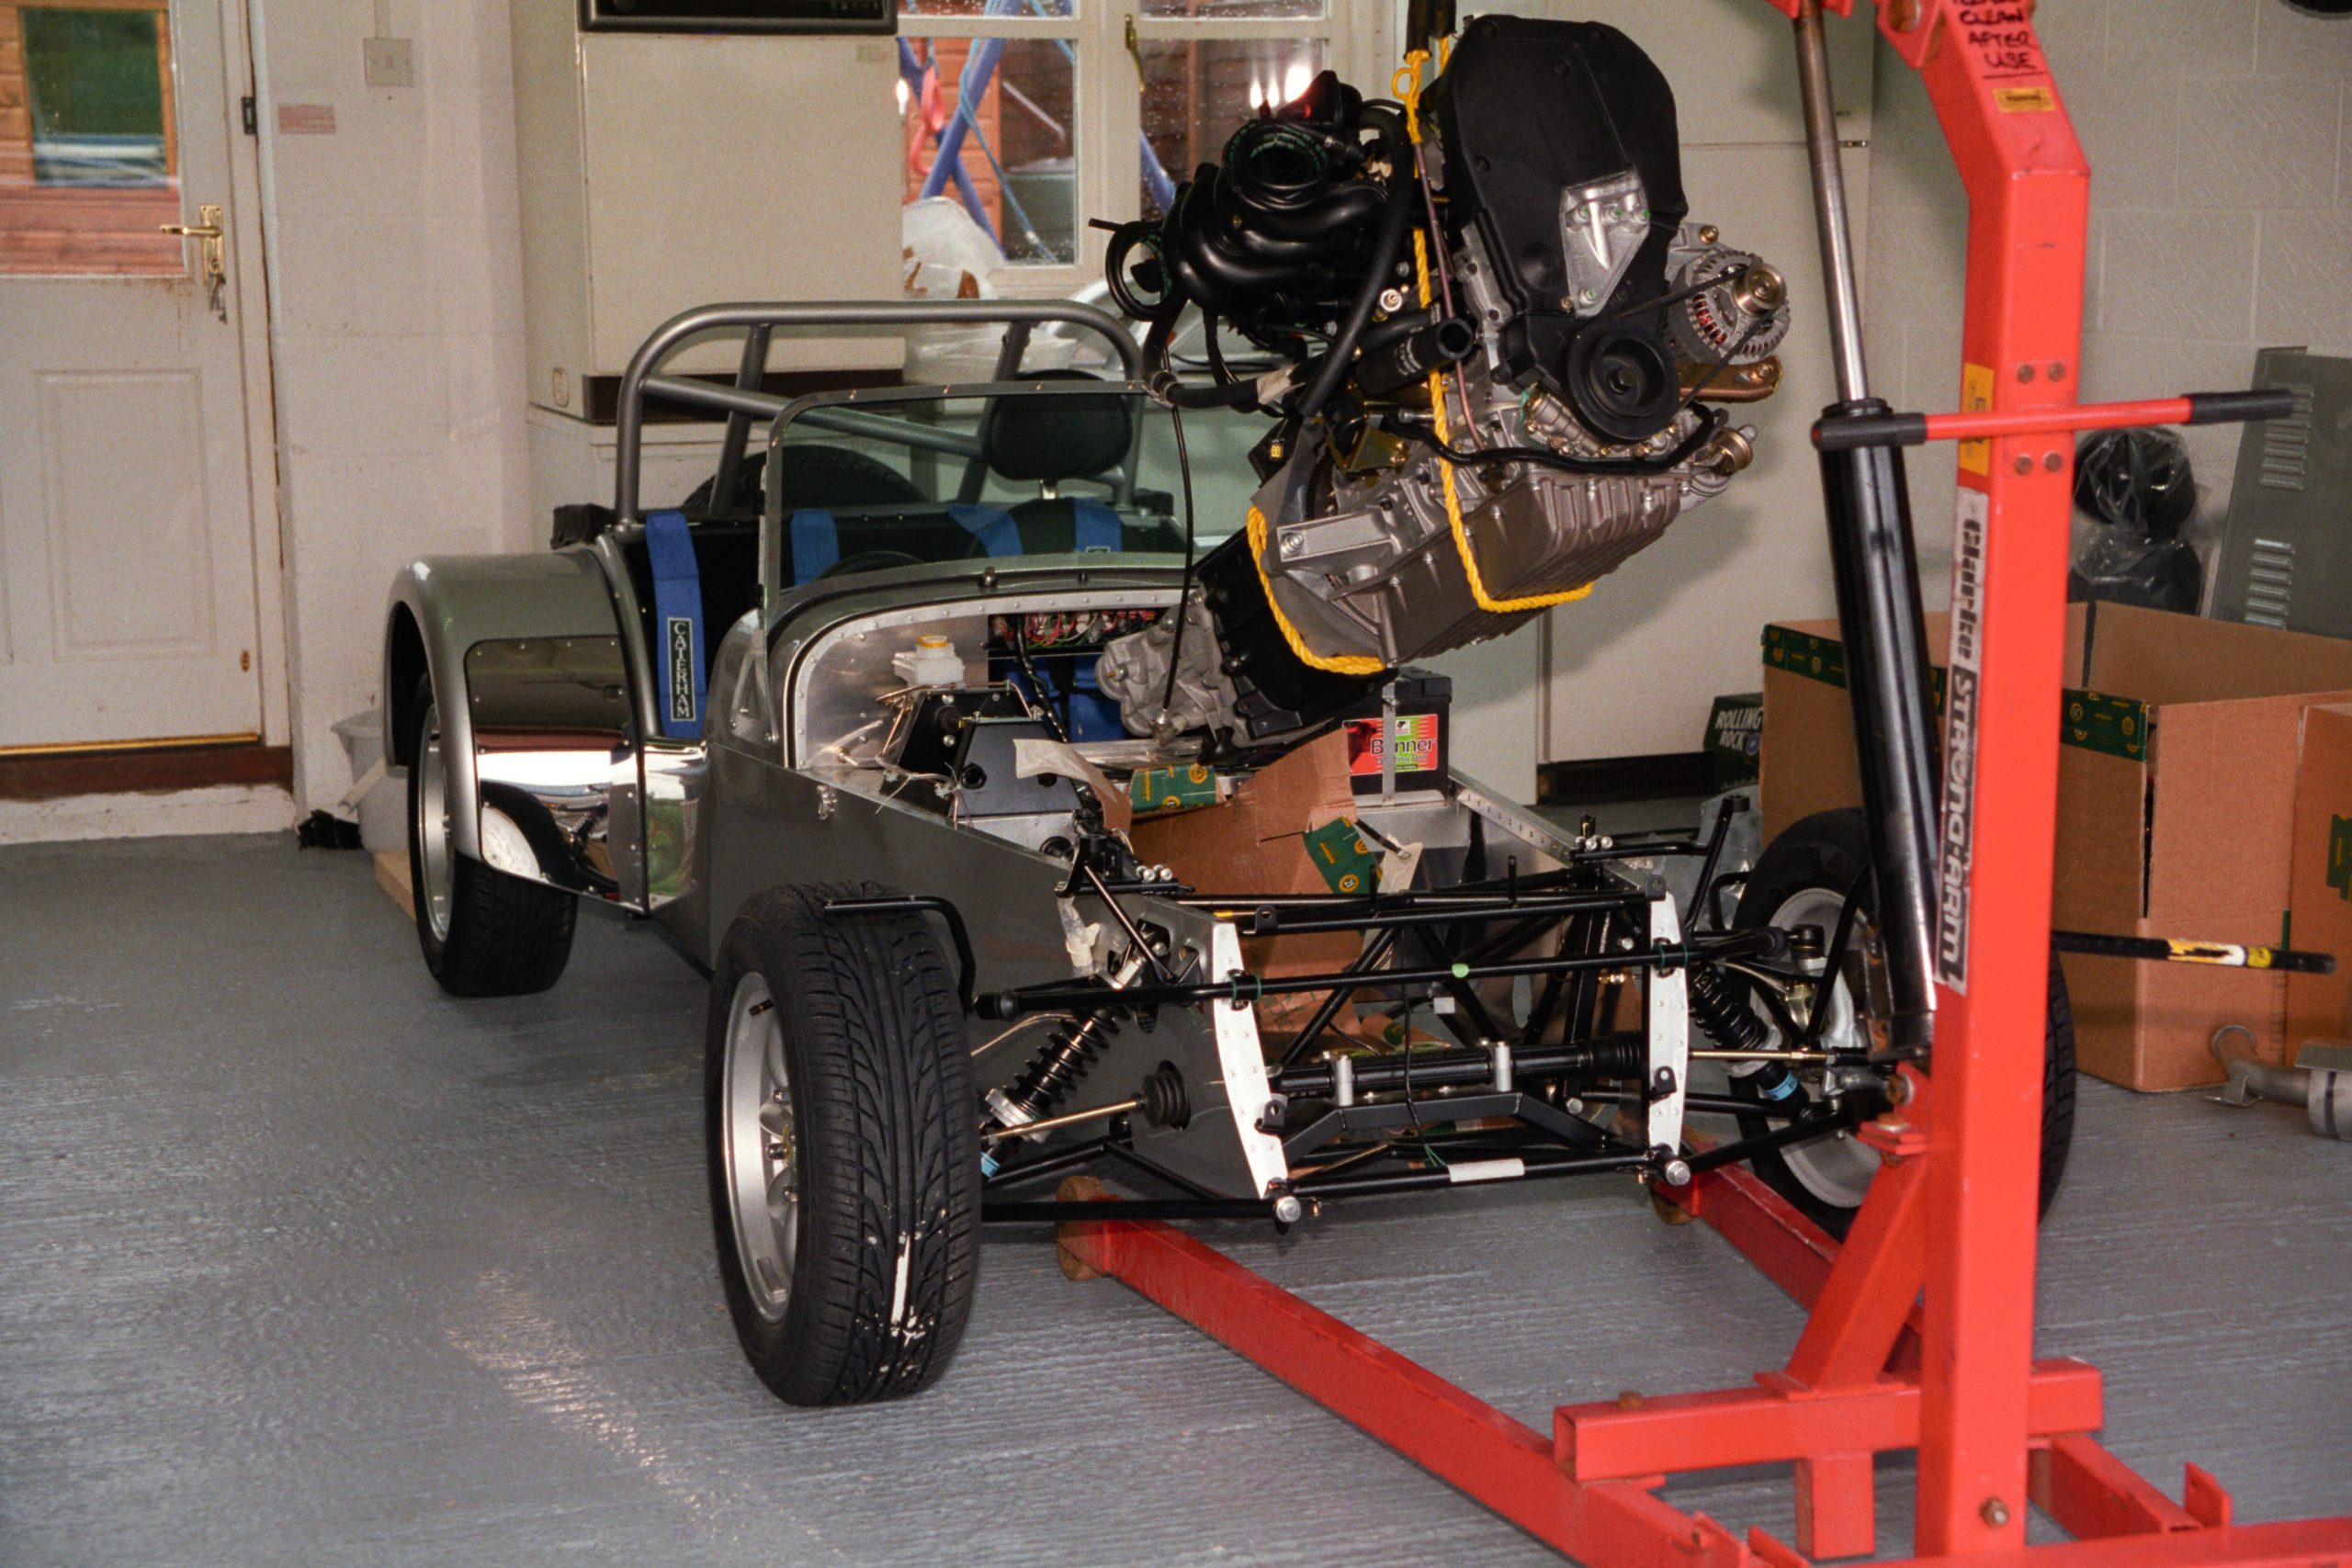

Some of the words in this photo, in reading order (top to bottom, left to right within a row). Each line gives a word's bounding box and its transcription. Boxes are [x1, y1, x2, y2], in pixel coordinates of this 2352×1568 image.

[1969, 30, 2030, 49] AFTER
[1984, 51, 2036, 70] USE
[673, 622, 691, 718] CATERHAM
[1714, 706, 1764, 730] ROLLING
[1371, 739, 1435, 755] Bnner
[1718, 730, 1747, 752] ROCK
